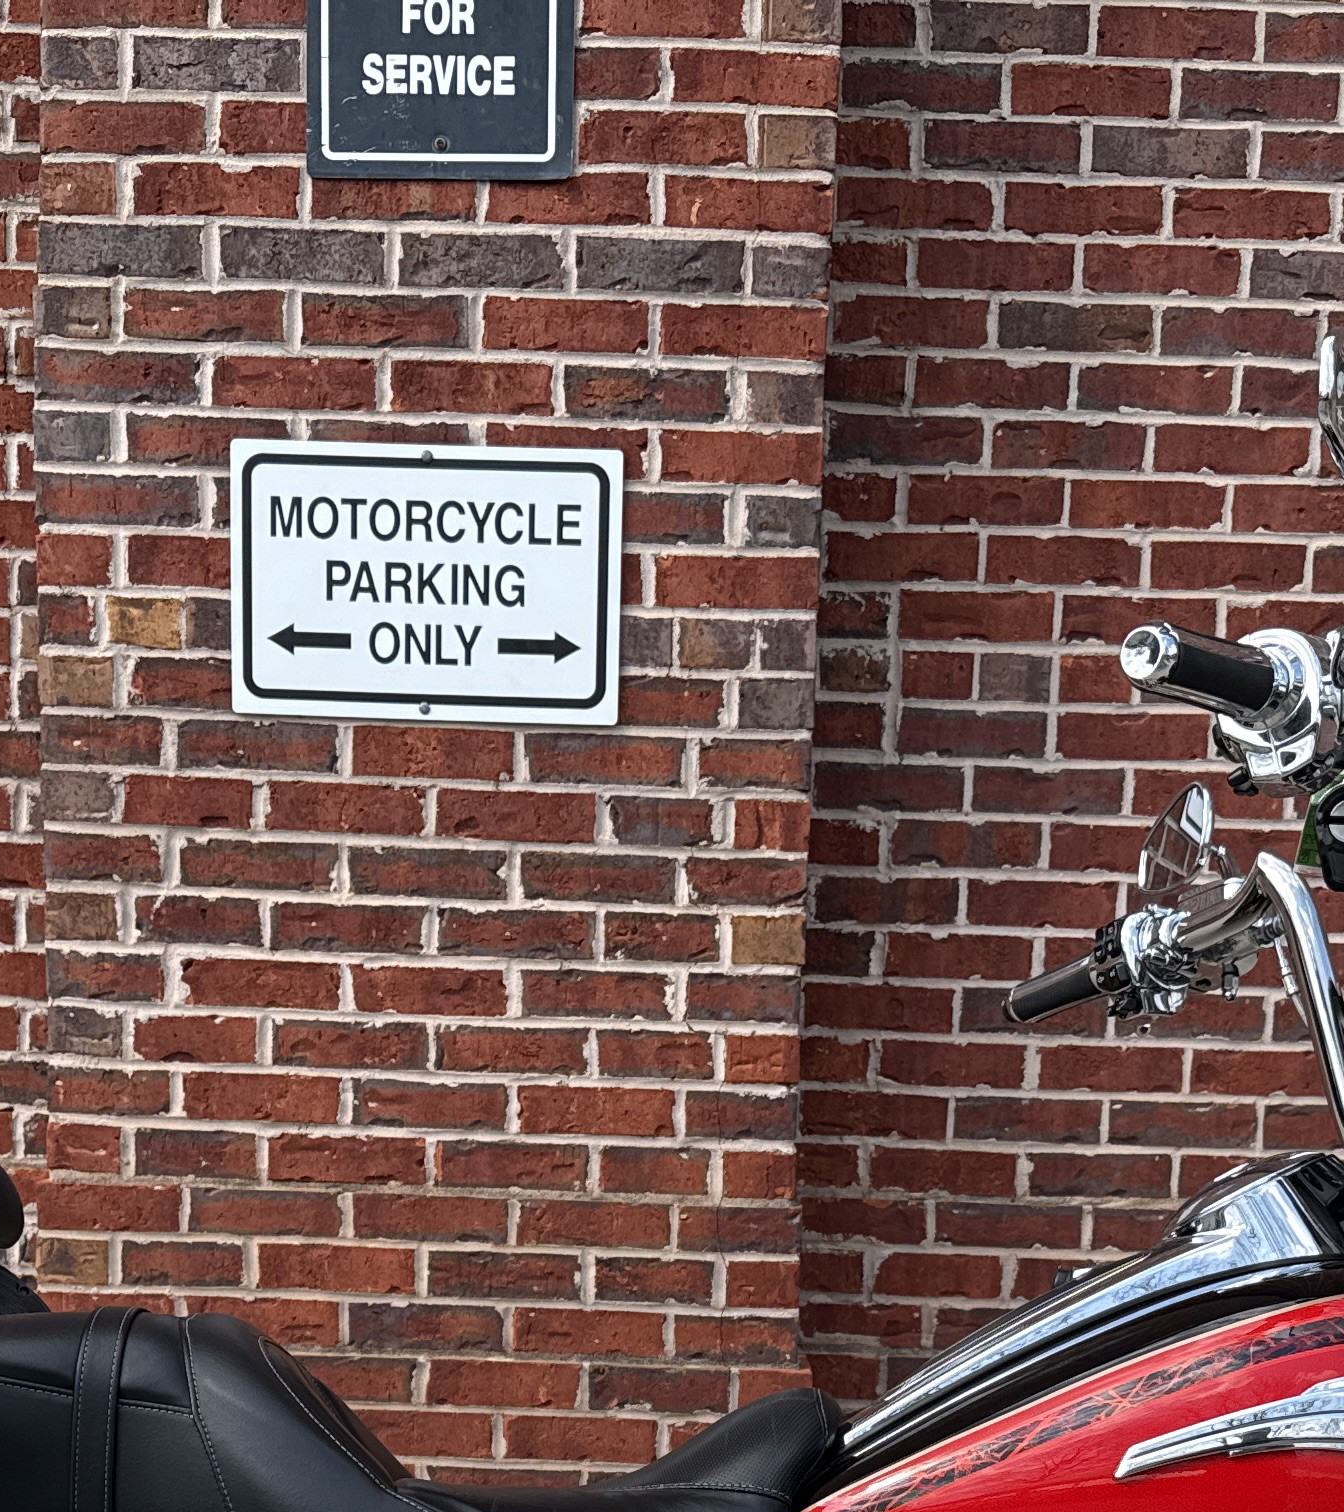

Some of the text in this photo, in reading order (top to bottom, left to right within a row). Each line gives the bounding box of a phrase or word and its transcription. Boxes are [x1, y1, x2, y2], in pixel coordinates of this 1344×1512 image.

[401, 0, 475, 35] FOR
[361, 52, 516, 97] SERVICE
[270, 495, 582, 546] MOTORCYCLE
[326, 560, 525, 608] PARKING
[369, 621, 482, 666] ONLY
